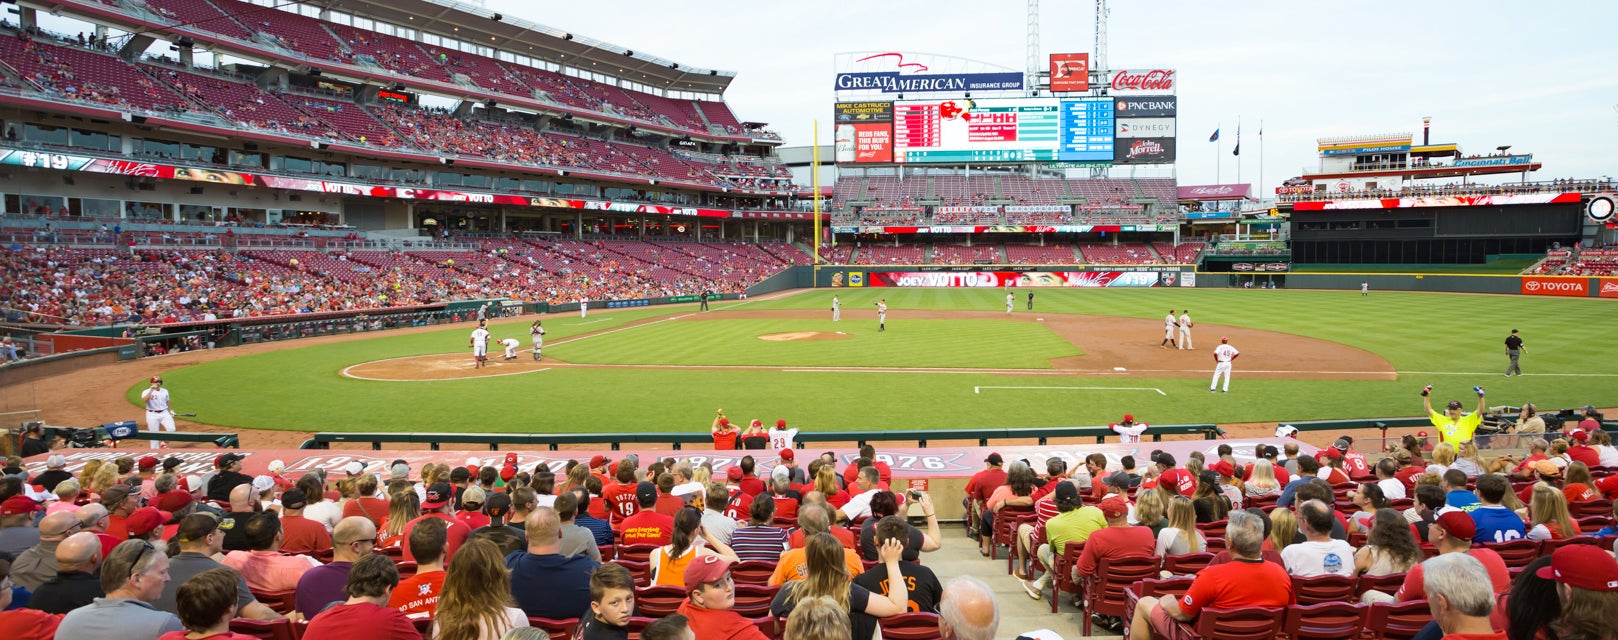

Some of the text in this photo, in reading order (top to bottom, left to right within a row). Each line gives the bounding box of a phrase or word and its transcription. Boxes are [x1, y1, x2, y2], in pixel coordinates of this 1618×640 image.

[838, 74, 890, 88] GREAT
[885, 77, 965, 91] AMERICAN
[1001, 81, 1020, 89] GROUP
[1111, 69, 1174, 91] Coca-Cola
[22, 152, 68, 170] #19
[1453, 155, 1531, 167] Cincinnati Bell
[324, 182, 352, 194] VOTTO
[468, 193, 493, 203] VOTTO
[897, 272, 978, 287] JOEY VOTTO
[1125, 273, 1148, 285] #19
[1541, 282, 1583, 291] TOYOTA
[774, 438, 786, 449] 29
[618, 501, 634, 516] 19
[408, 599, 423, 609] SAN
